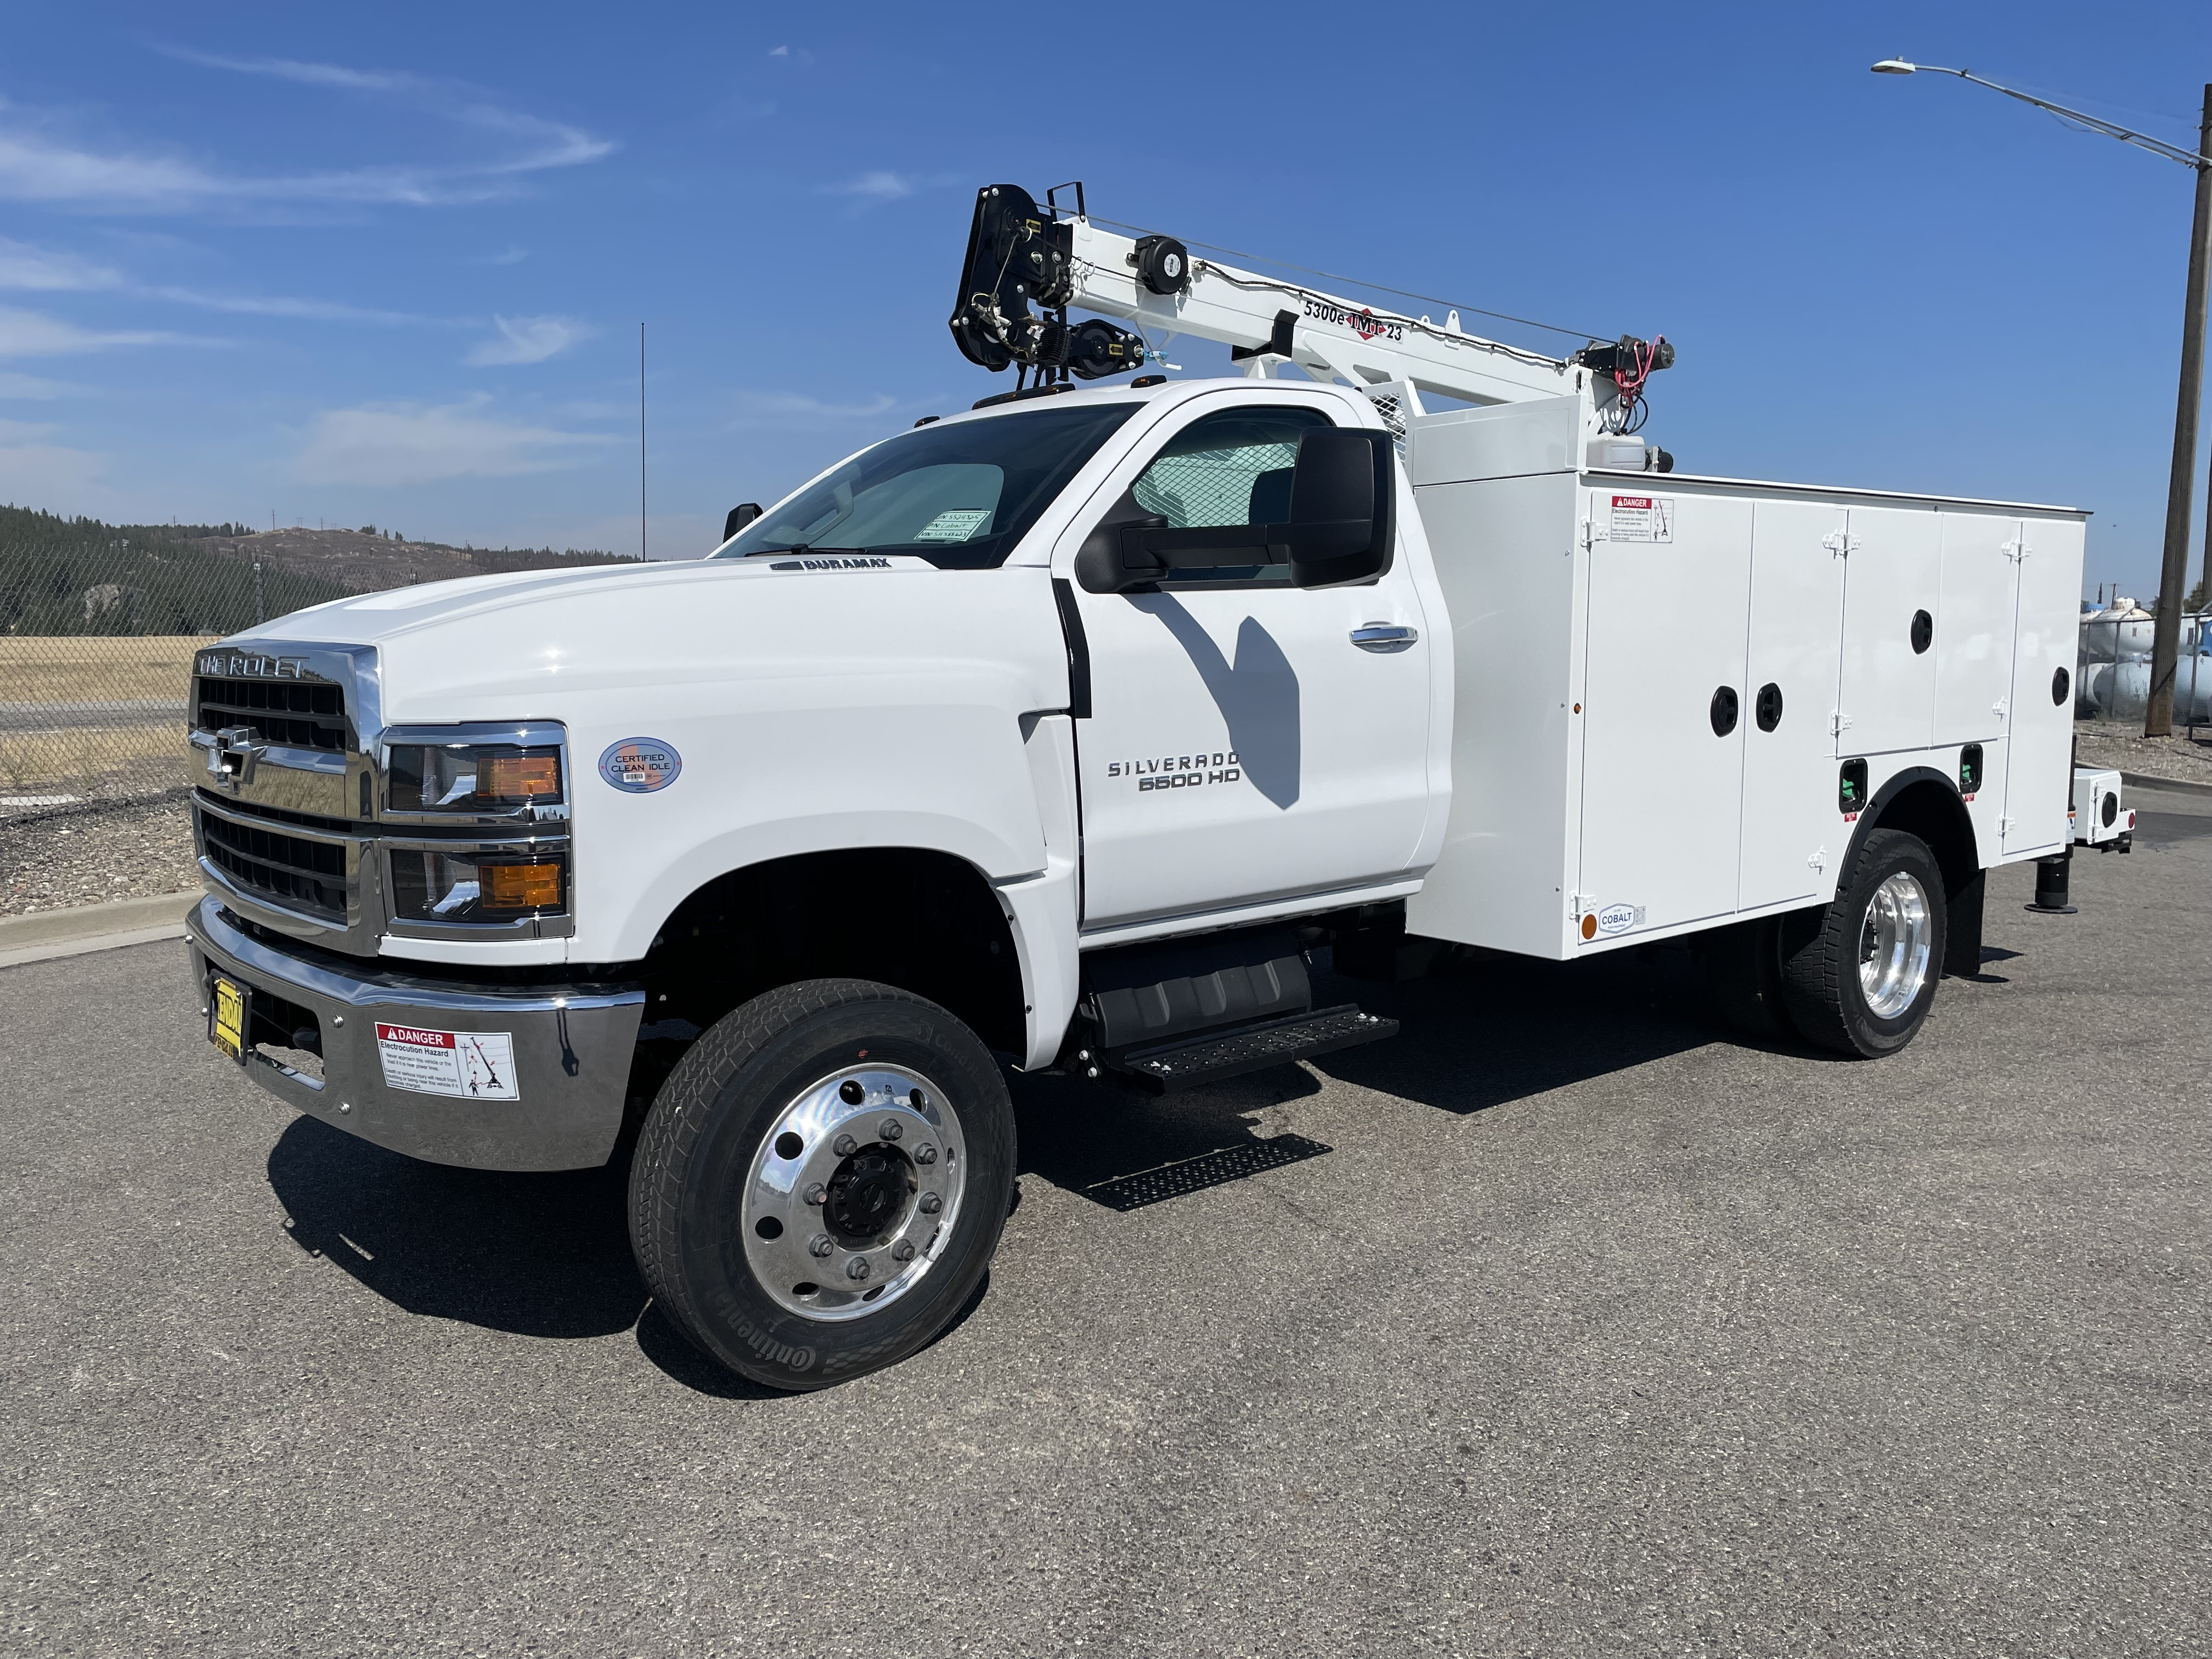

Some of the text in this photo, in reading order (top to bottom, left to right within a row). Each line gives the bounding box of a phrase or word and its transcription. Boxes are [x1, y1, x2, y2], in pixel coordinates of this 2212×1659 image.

[1304, 300, 1402, 341] 5300e IMT 23
[1623, 498, 1647, 507] DANGER
[803, 558, 893, 571] DURAMAX
[615, 754, 665, 763] CERTIFIED
[1108, 751, 1239, 777] SILVERADO
[611, 764, 645, 772] CLEAN
[1207, 768, 1240, 785] HD
[1602, 912, 1632, 925] COBALT
[398, 1029, 444, 1046] DANGER
[380, 1041, 449, 1057] Electrocution Hazard
